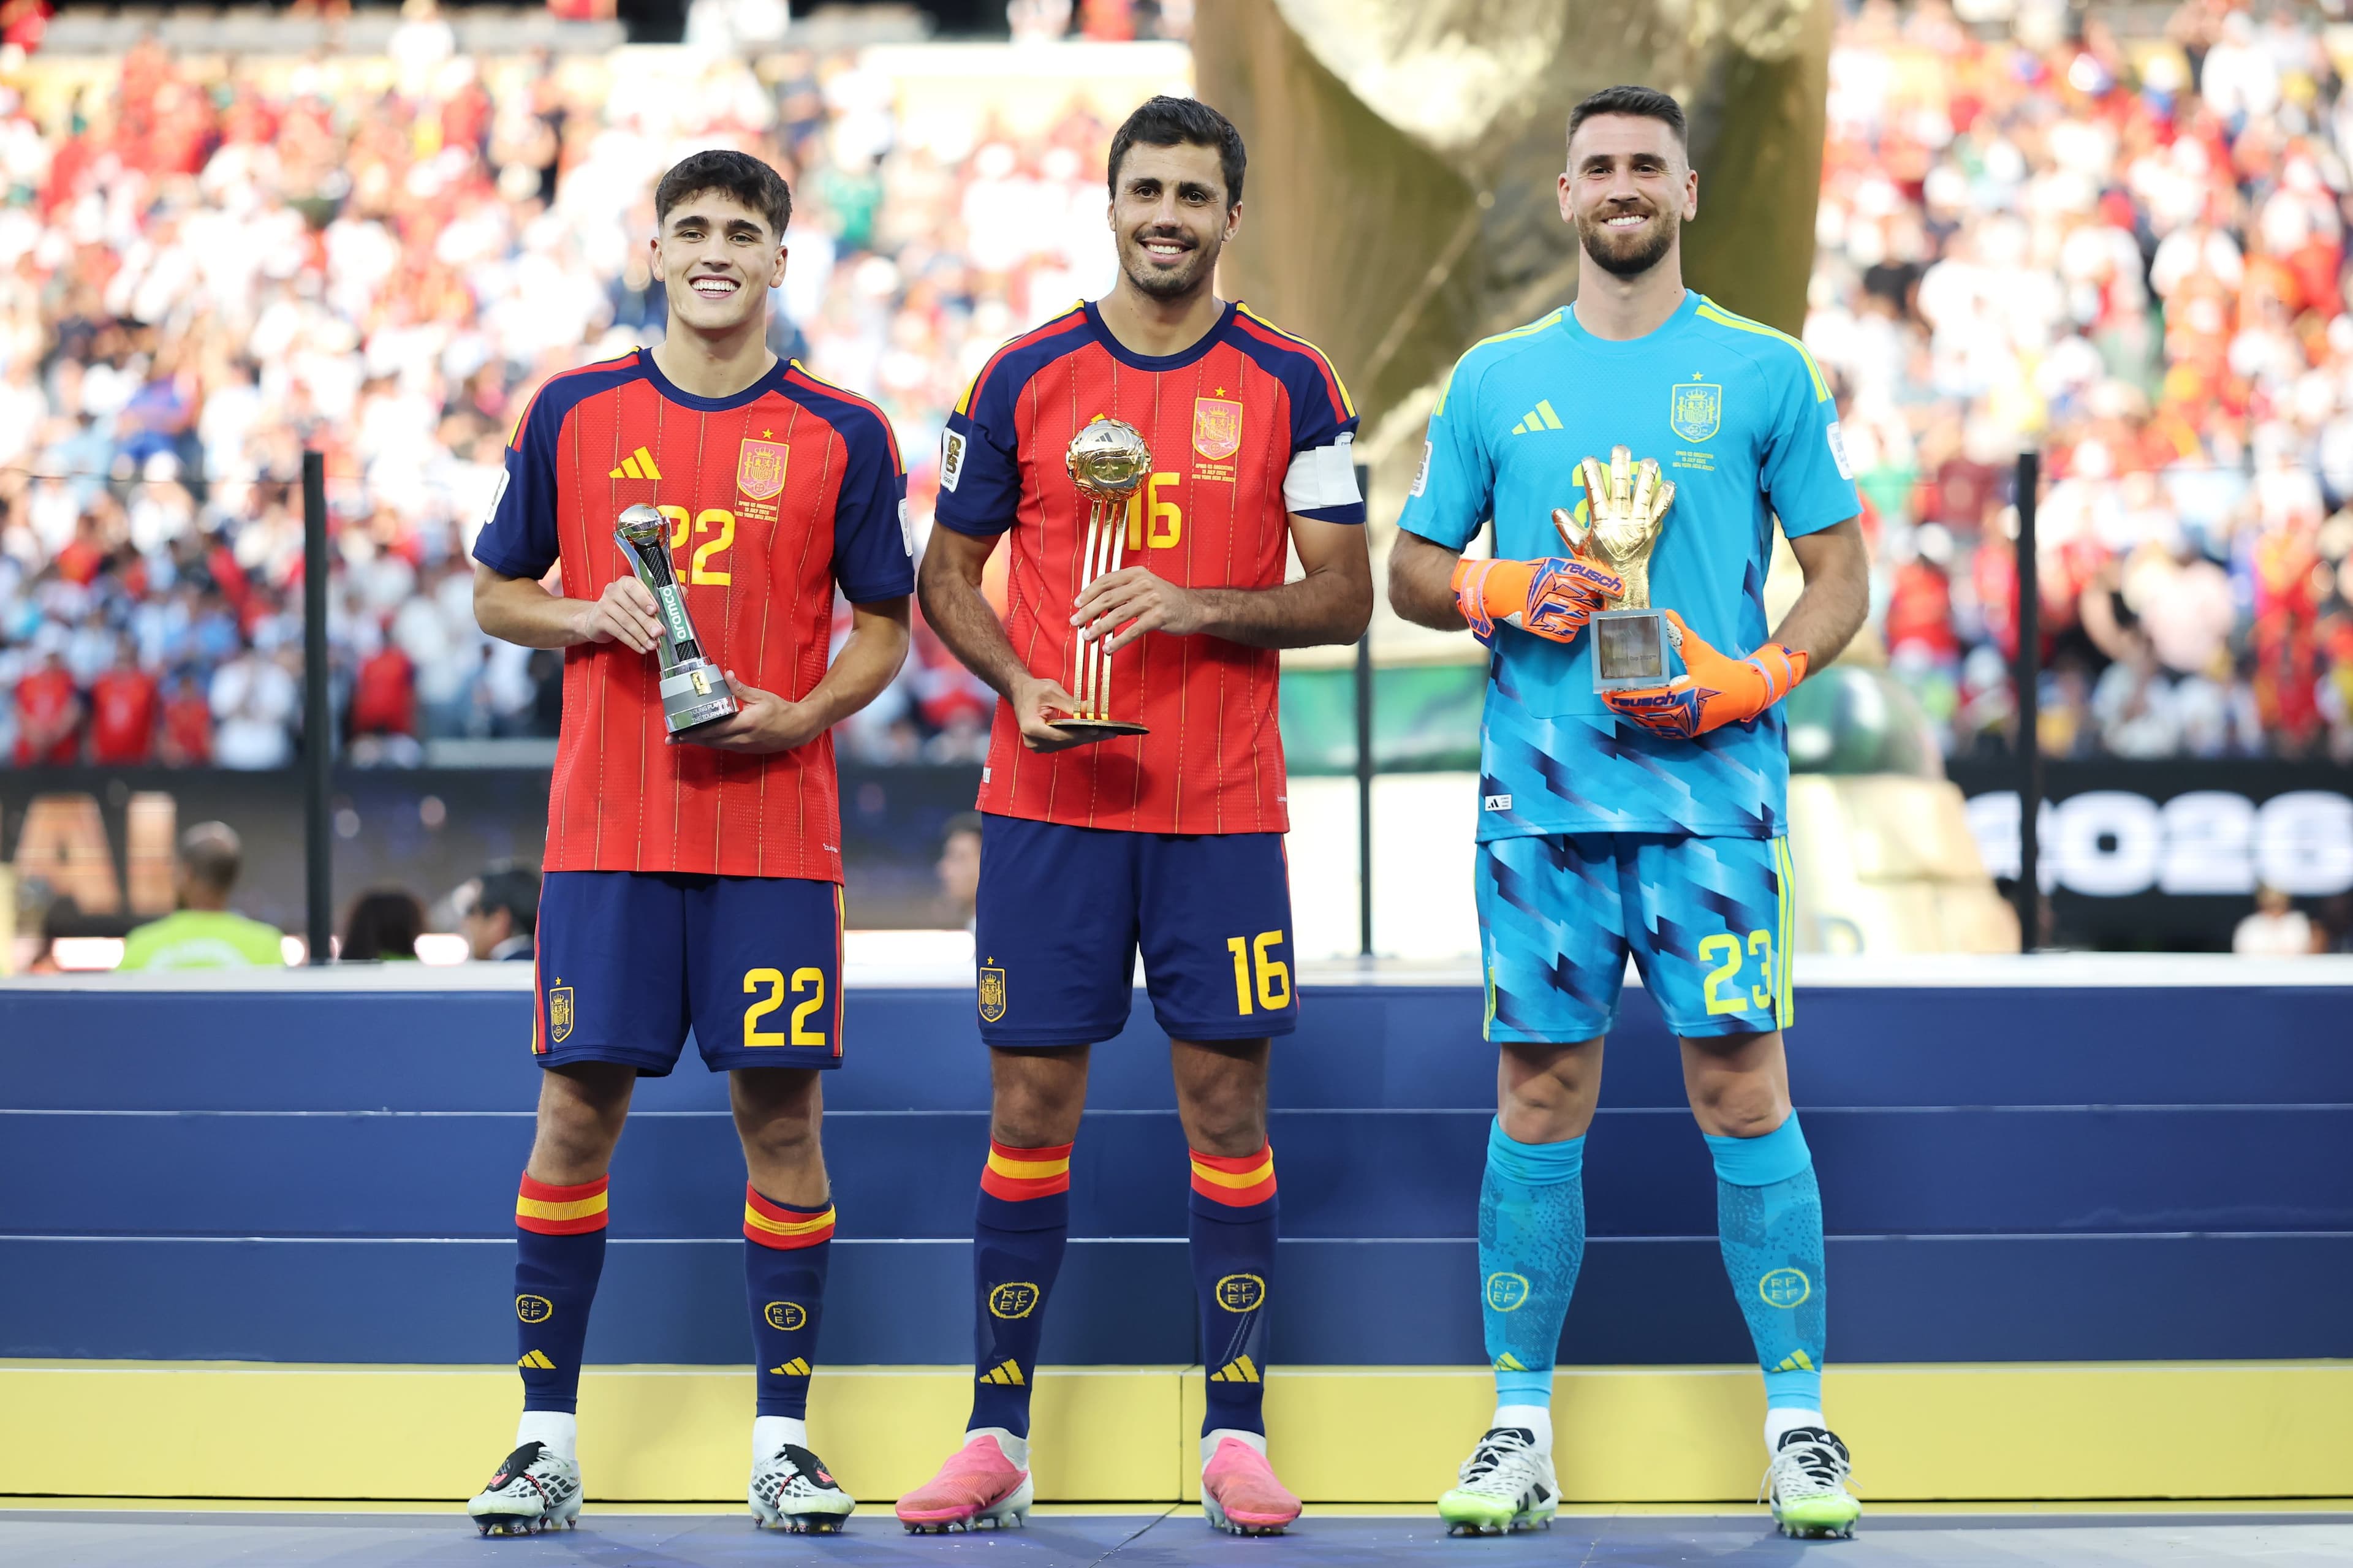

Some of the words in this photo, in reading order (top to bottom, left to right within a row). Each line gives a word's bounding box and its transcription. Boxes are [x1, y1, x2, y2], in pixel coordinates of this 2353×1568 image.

[1127, 472, 1182, 550] 16
[1563, 562, 1622, 592] reusch
[662, 588, 686, 639] aramco
[1612, 691, 1676, 706] reusch
[1227, 930, 1290, 1015] 16
[1699, 930, 1771, 1015] 23
[743, 968, 825, 1047] 22
[1227, 1282, 1254, 1292] RF
[1495, 1280, 1518, 1290] RF
[1771, 1276, 1797, 1287] RF
[1001, 1289, 1029, 1301] RF
[1493, 1291, 1515, 1303] EF
[1771, 1288, 1798, 1300] EF
[521, 1300, 541, 1309] RF
[1000, 1300, 1028, 1311] EF
[521, 1308, 540, 1317] EF
[775, 1316, 796, 1324] EF
